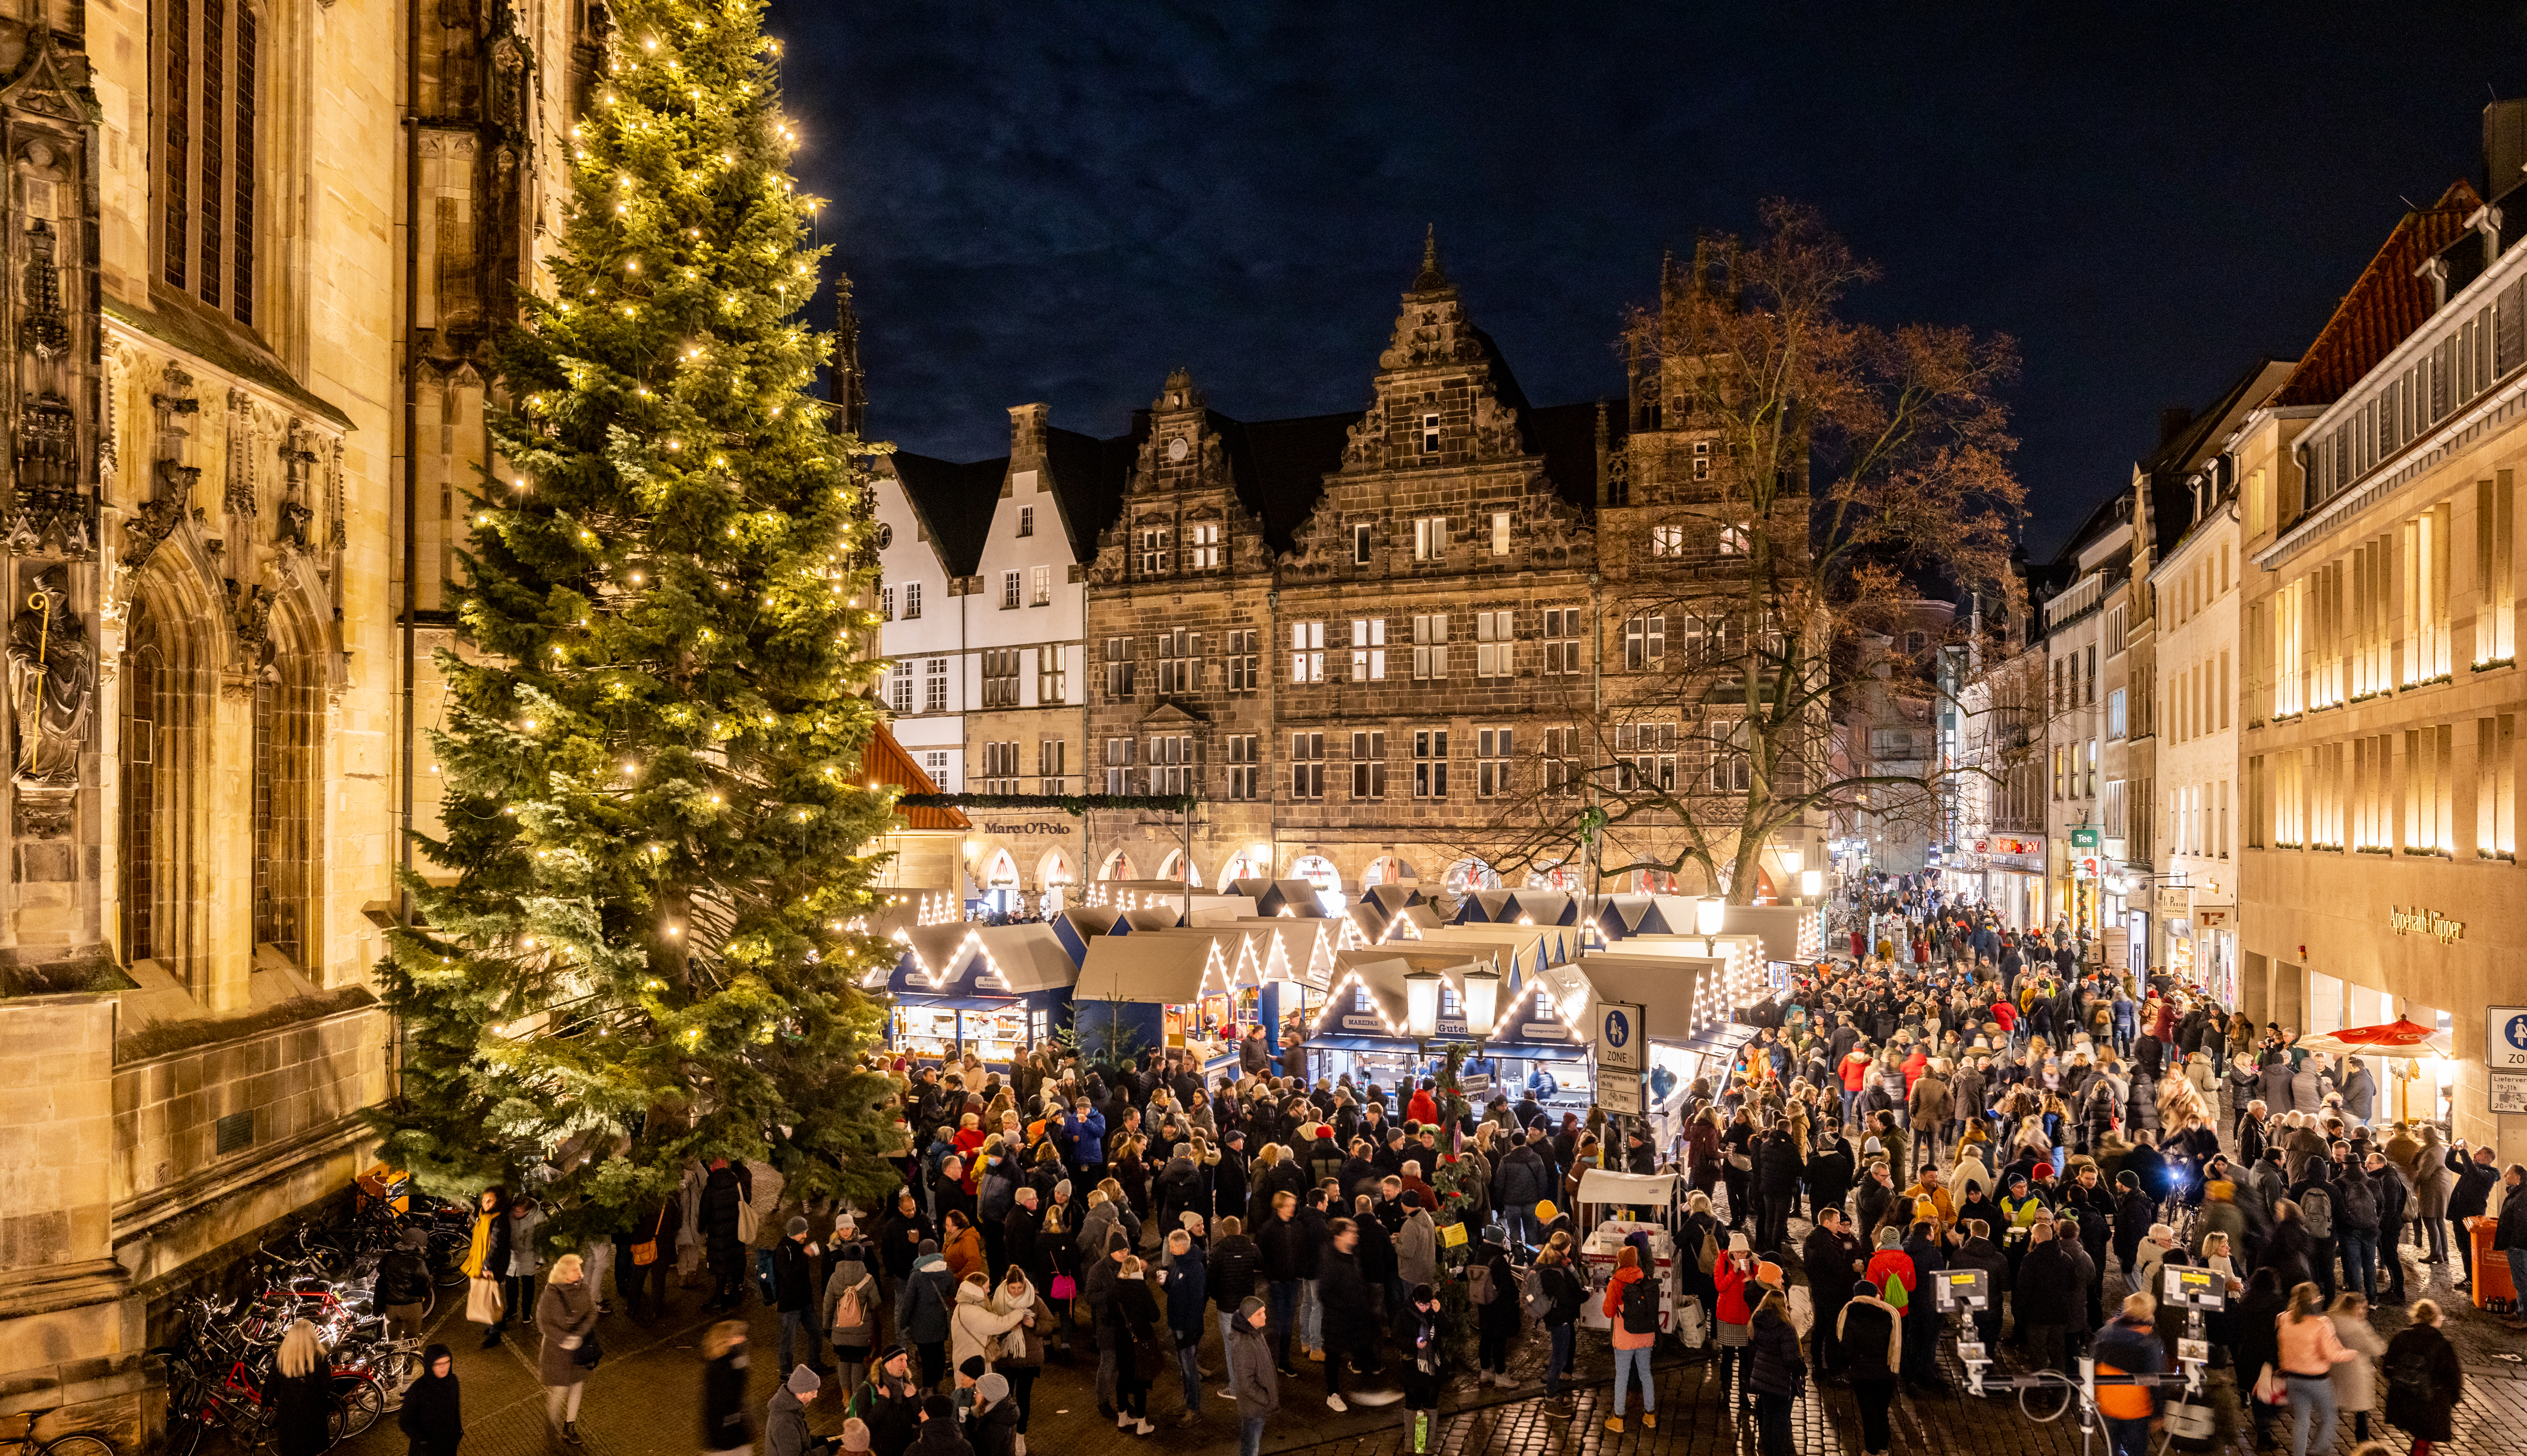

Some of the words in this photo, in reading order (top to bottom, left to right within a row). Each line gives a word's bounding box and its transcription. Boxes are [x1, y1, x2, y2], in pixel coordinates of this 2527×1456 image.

[984, 822, 1020, 834] Marc
[2077, 834, 2093, 843] Tee
[2170, 896, 2186, 907] Panino
[2390, 905, 2462, 945] Appelrath-Cüpper
[1607, 1051, 1628, 1063] ZONE
[2509, 1054, 2527, 1064] ZO
[1599, 1073, 1628, 1082] Lieferverkehr
